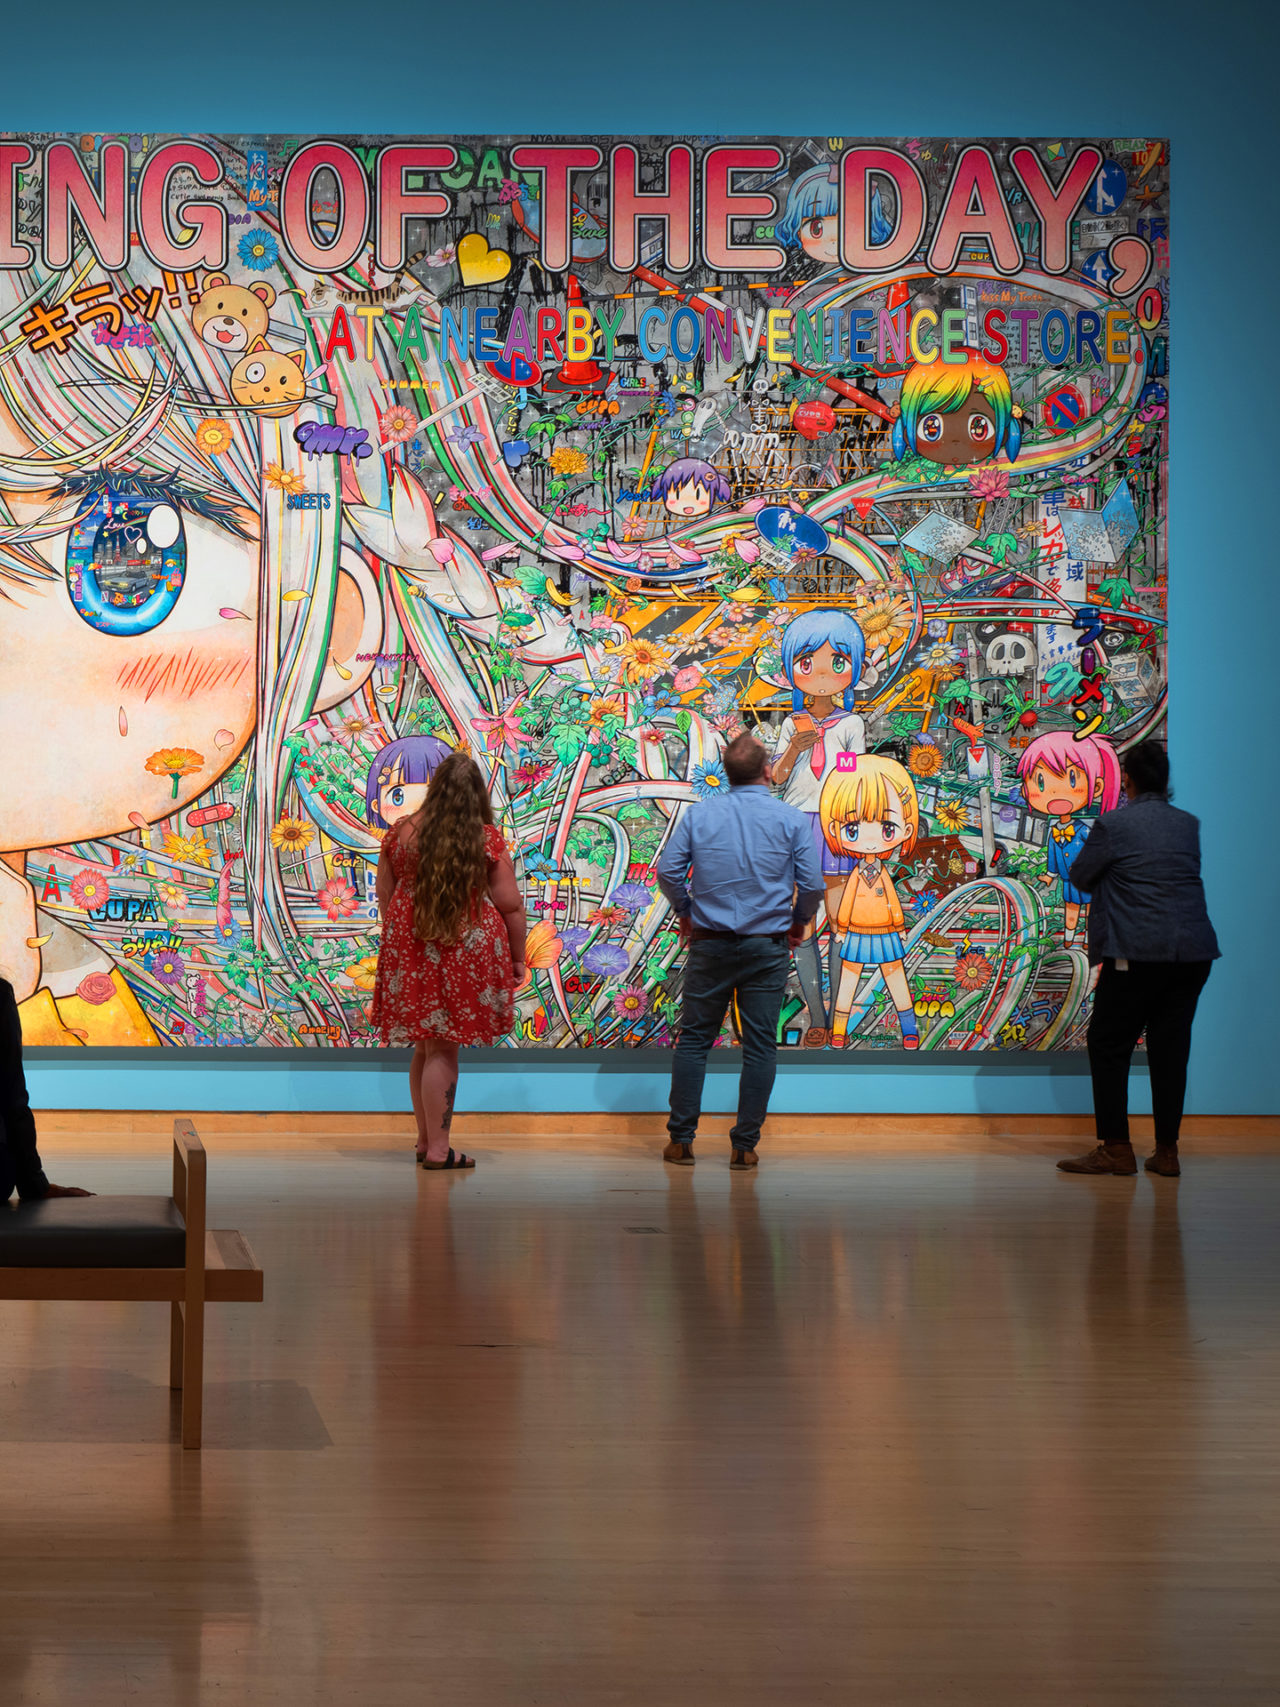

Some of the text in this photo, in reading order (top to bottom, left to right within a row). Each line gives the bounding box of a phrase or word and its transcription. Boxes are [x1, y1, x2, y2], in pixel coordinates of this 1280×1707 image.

[278, 139, 459, 275] OF
[509, 142, 787, 273] THE
[838, 142, 1155, 298] DAY,
[323, 304, 1145, 367] AT A NEARBY CONVENIENCE STORE.
[379, 378, 442, 392] SUMMER
[619, 376, 647, 389] GIRLS
[574, 400, 620, 417] CUPA
[286, 492, 332, 511] SWEETS
[332, 853, 361, 869] Car
[912, 1000, 956, 1018] UPA
[298, 1024, 342, 1041] Amazing
